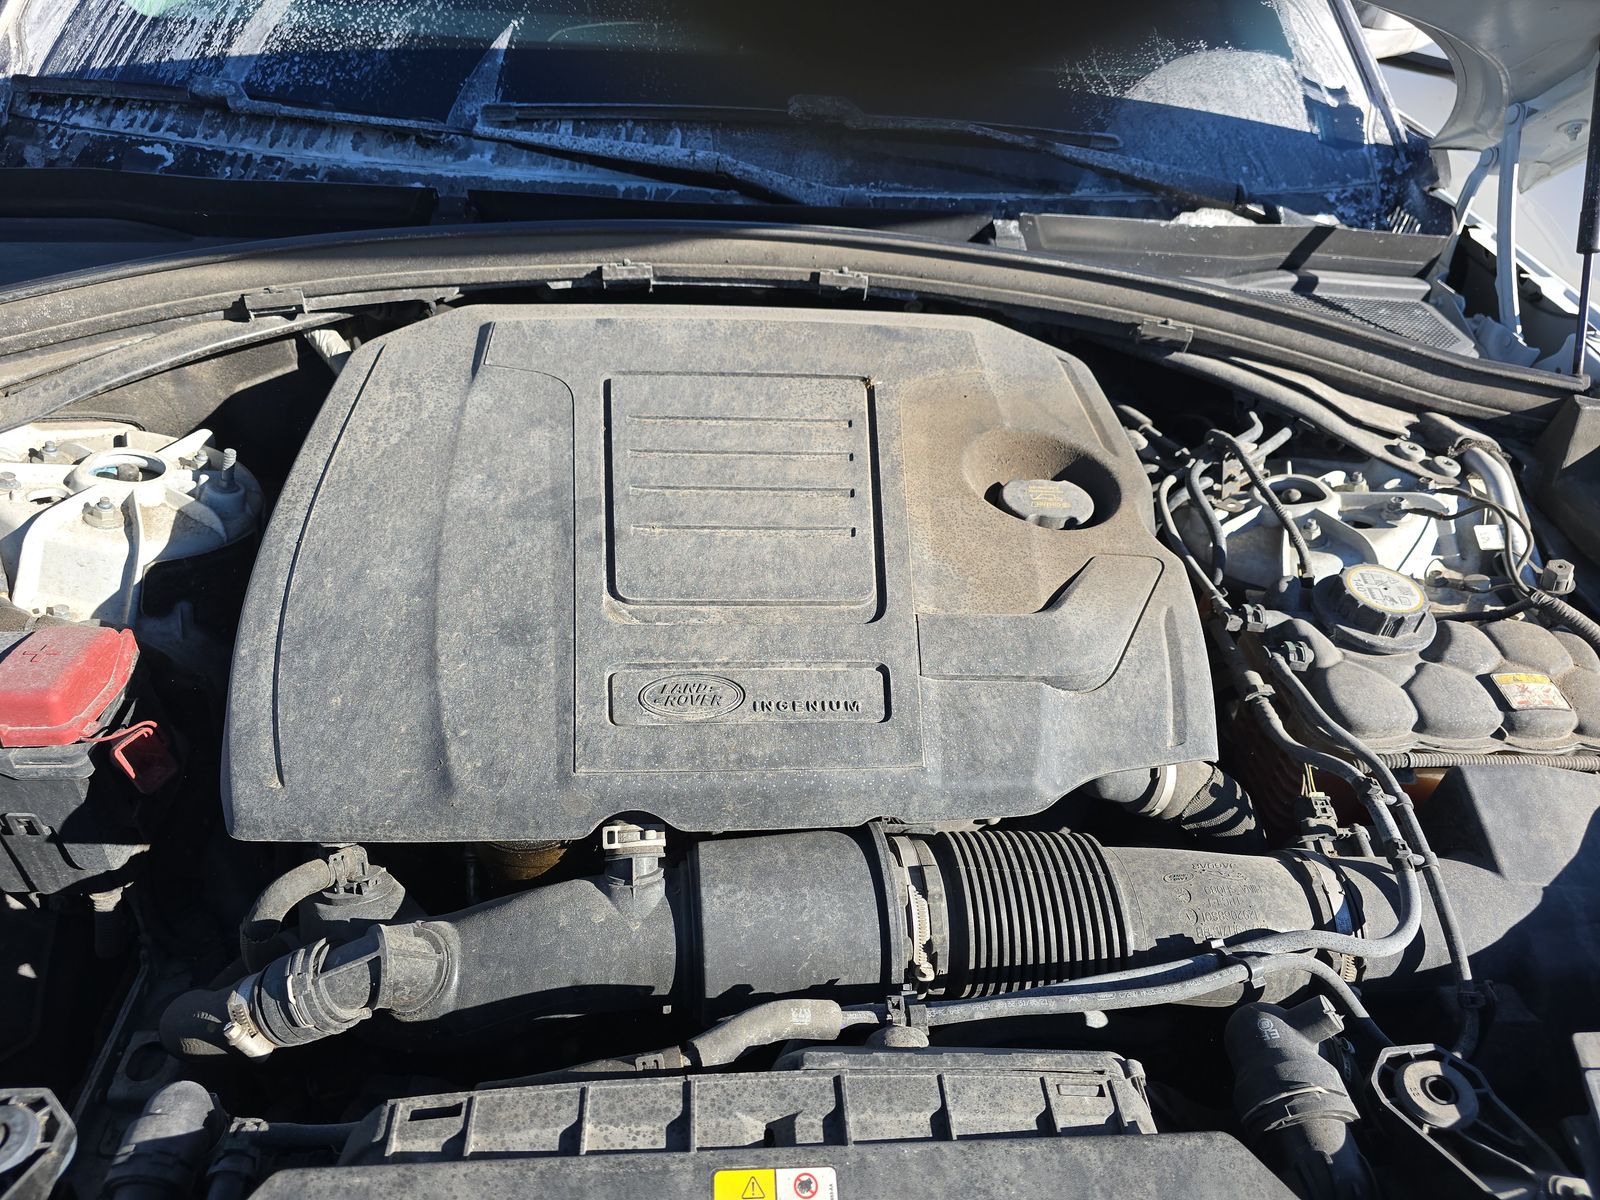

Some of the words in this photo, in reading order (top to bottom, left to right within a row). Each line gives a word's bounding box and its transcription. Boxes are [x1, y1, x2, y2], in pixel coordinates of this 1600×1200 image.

[660, 683, 712, 695] LAND
[664, 694, 722, 707] ROVER
[752, 700, 861, 713] INGENIUM
